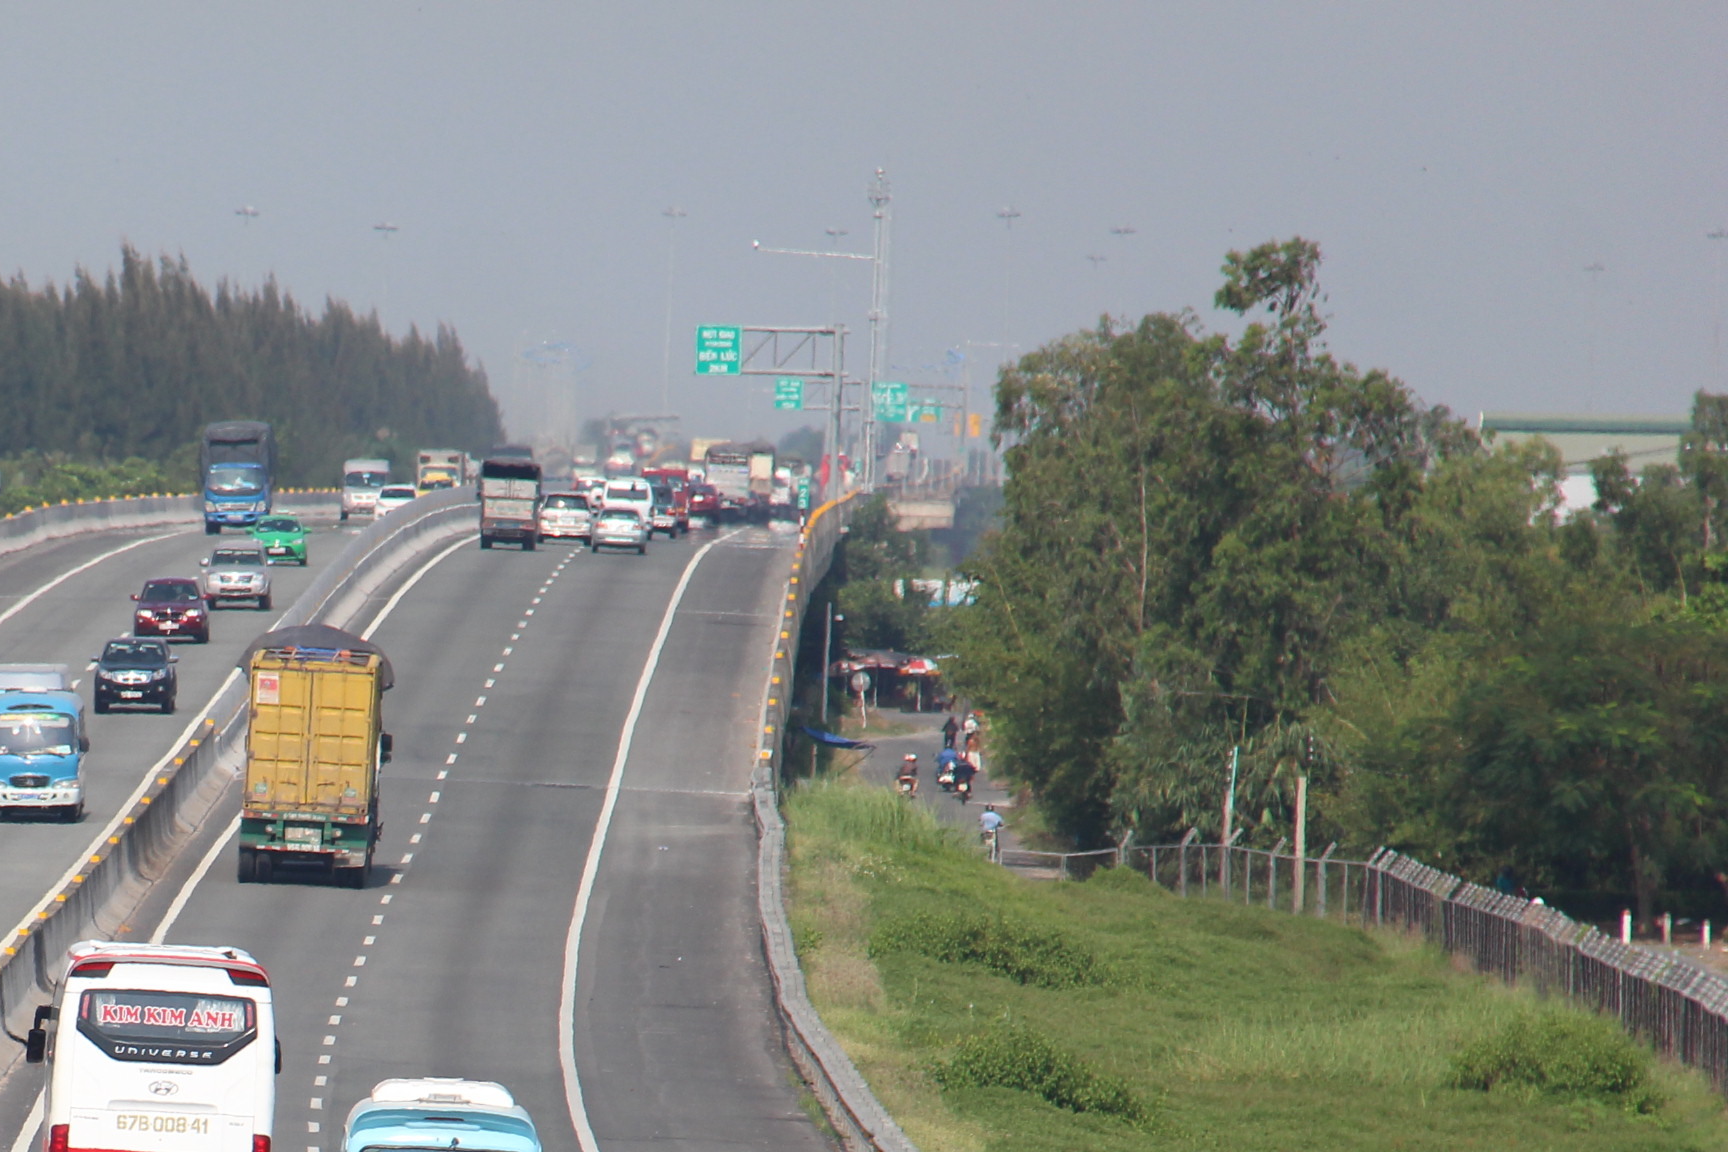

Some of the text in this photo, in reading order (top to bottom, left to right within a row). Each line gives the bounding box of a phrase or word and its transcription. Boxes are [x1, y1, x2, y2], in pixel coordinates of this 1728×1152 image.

[101, 1004, 236, 1029] KIM KIM ANH
[113, 1045, 214, 1060] UNIVERSE
